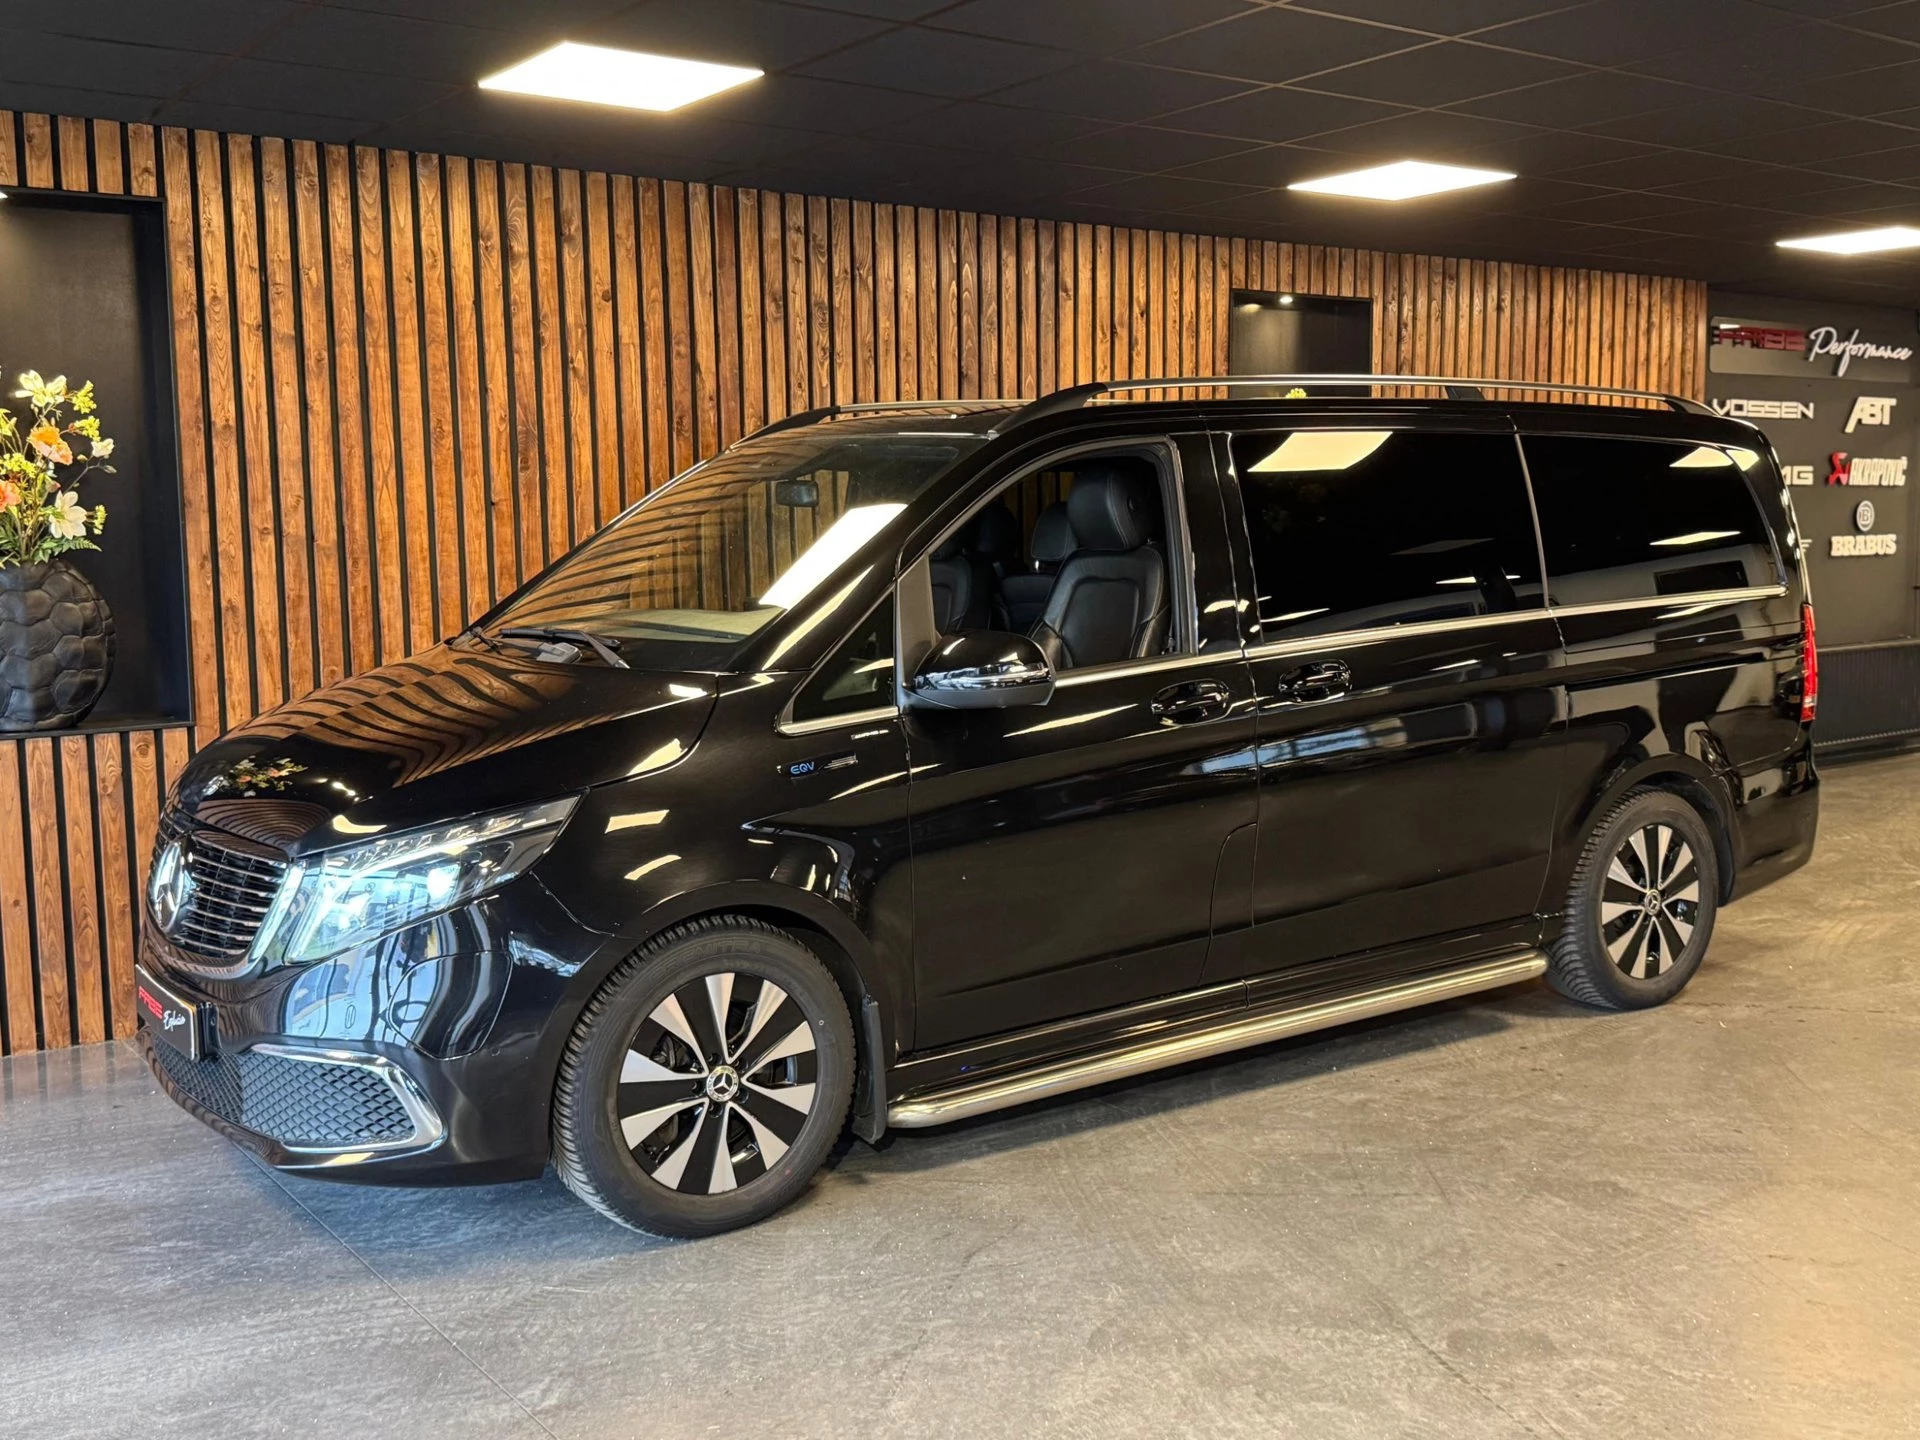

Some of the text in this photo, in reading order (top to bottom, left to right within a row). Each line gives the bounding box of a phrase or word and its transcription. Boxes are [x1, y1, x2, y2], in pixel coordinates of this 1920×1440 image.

[1809, 326, 1913, 378] Performance
[1712, 398, 1814, 420] VOSSEN
[1844, 396, 1897, 433] ABT
[1830, 534, 1897, 557] BRABUS
[790, 761, 815, 775] EQV
